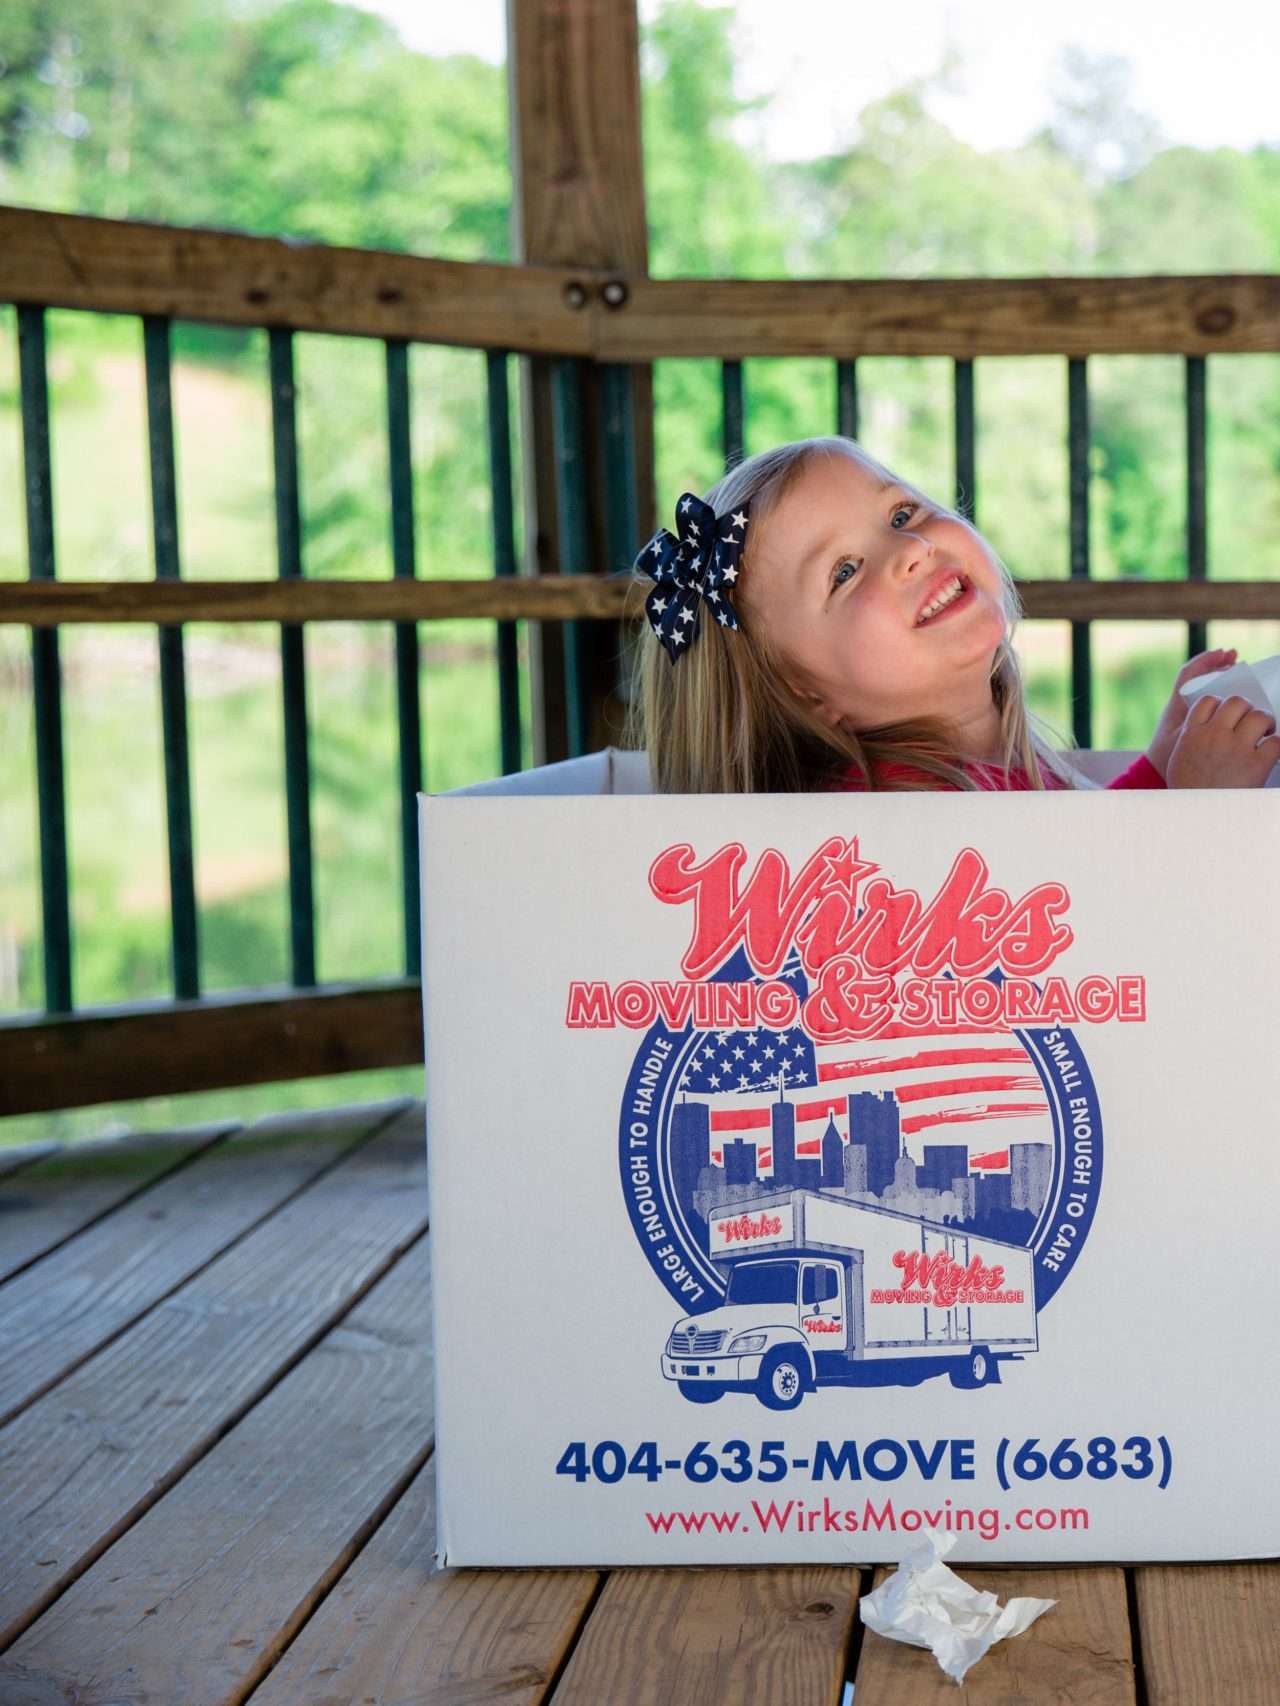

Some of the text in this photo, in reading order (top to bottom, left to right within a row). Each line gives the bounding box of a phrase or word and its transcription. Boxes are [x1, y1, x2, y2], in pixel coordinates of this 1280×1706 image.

[648, 834, 1073, 980] Wirks
[566, 954, 1146, 1042] MOVING & STORAGE
[630, 1037, 704, 1302] LARGE ENOUGH TO HANDLE
[1042, 1031, 1093, 1272] SMALL ENOUGH TO CARE
[718, 1213, 782, 1244] Wirks
[870, 1285, 1024, 1307] MOVING & STORAGE
[892, 1250, 1005, 1290] Wirks
[555, 1435, 1173, 1491] 404-635-MOVE (6683)
[645, 1497, 1090, 1541] www.WirksMoving.com
